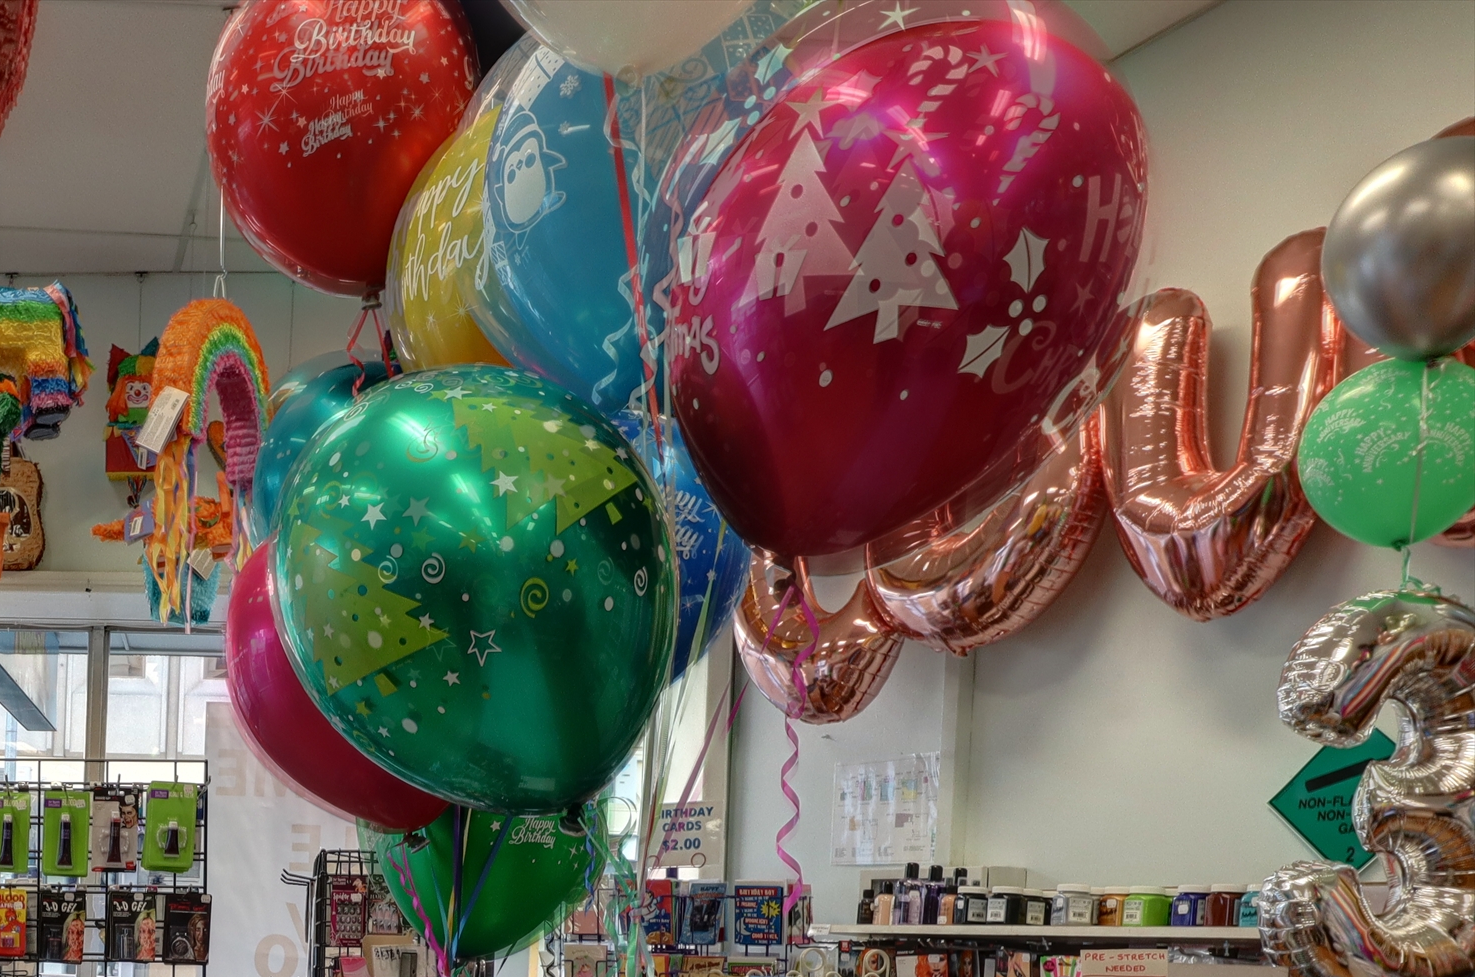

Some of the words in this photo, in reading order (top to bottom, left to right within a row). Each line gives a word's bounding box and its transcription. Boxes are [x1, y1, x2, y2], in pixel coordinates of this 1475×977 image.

[290, 18, 417, 62] Birthday
[1355, 428, 1388, 456] HAPPY
[659, 806, 714, 819] IRTHDAY
[662, 821, 702, 832] CARDS
[662, 838, 701, 853] $2.00
[1346, 846, 1355, 862] 2
[43, 901, 58, 911] 3-D
[61, 901, 77, 911] GEL
[113, 901, 129, 911] 3-D
[131, 901, 147, 911] GEL
[1085, 953, 1105, 961] PRE
[1117, 953, 1166, 961] STRETCH
[1105, 965, 1146, 973] NEEDED
